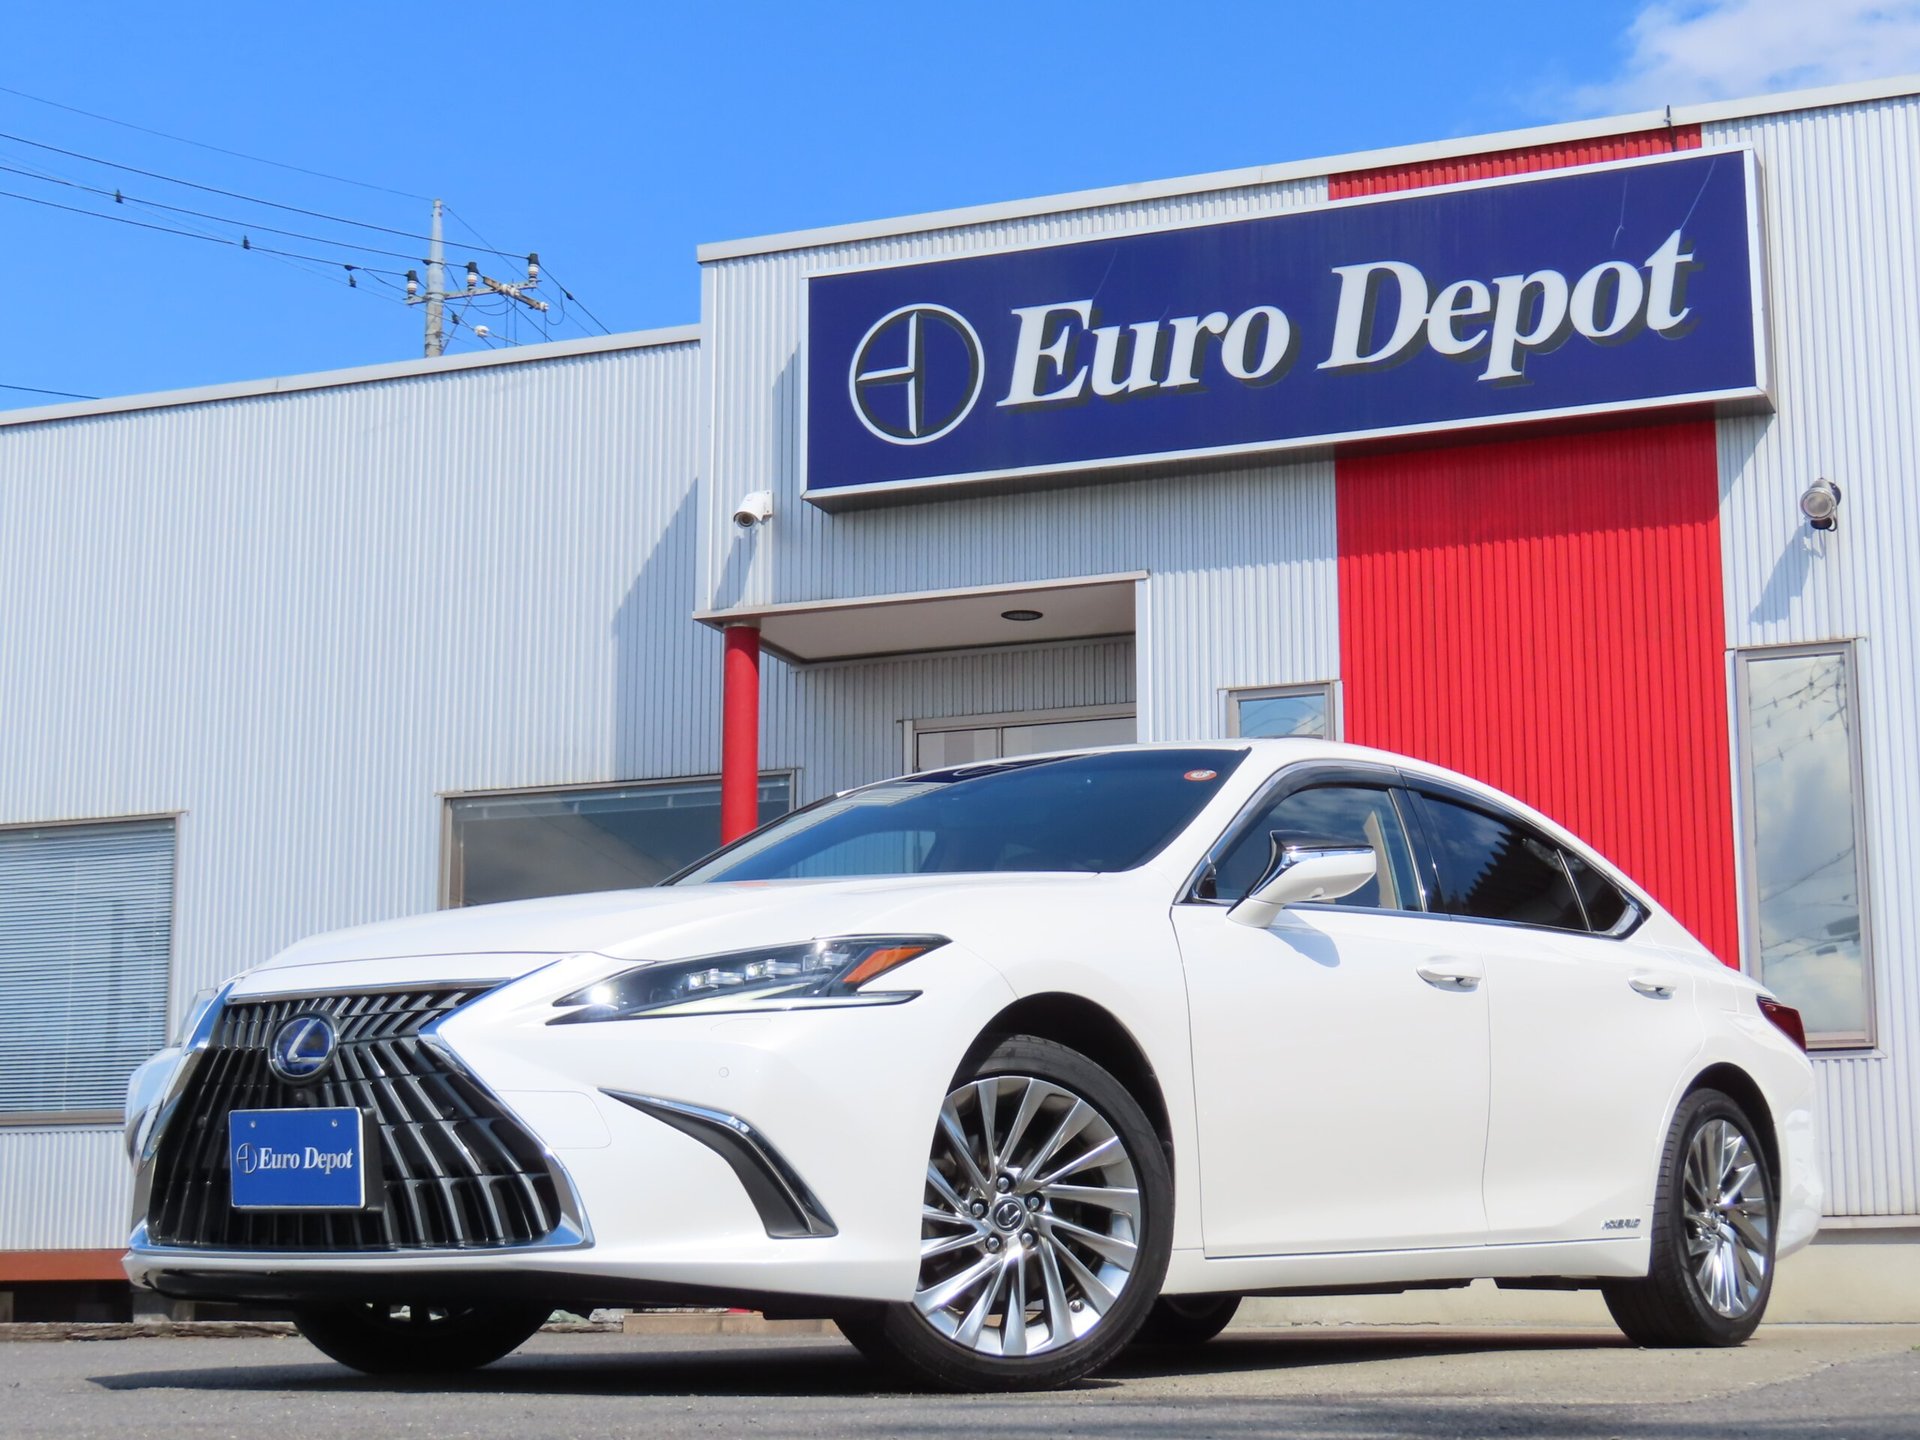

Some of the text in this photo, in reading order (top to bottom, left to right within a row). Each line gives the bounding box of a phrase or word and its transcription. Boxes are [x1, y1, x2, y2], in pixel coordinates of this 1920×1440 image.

[996, 229, 1694, 408] Euro Depot
[259, 1146, 353, 1174] Euro Depot
